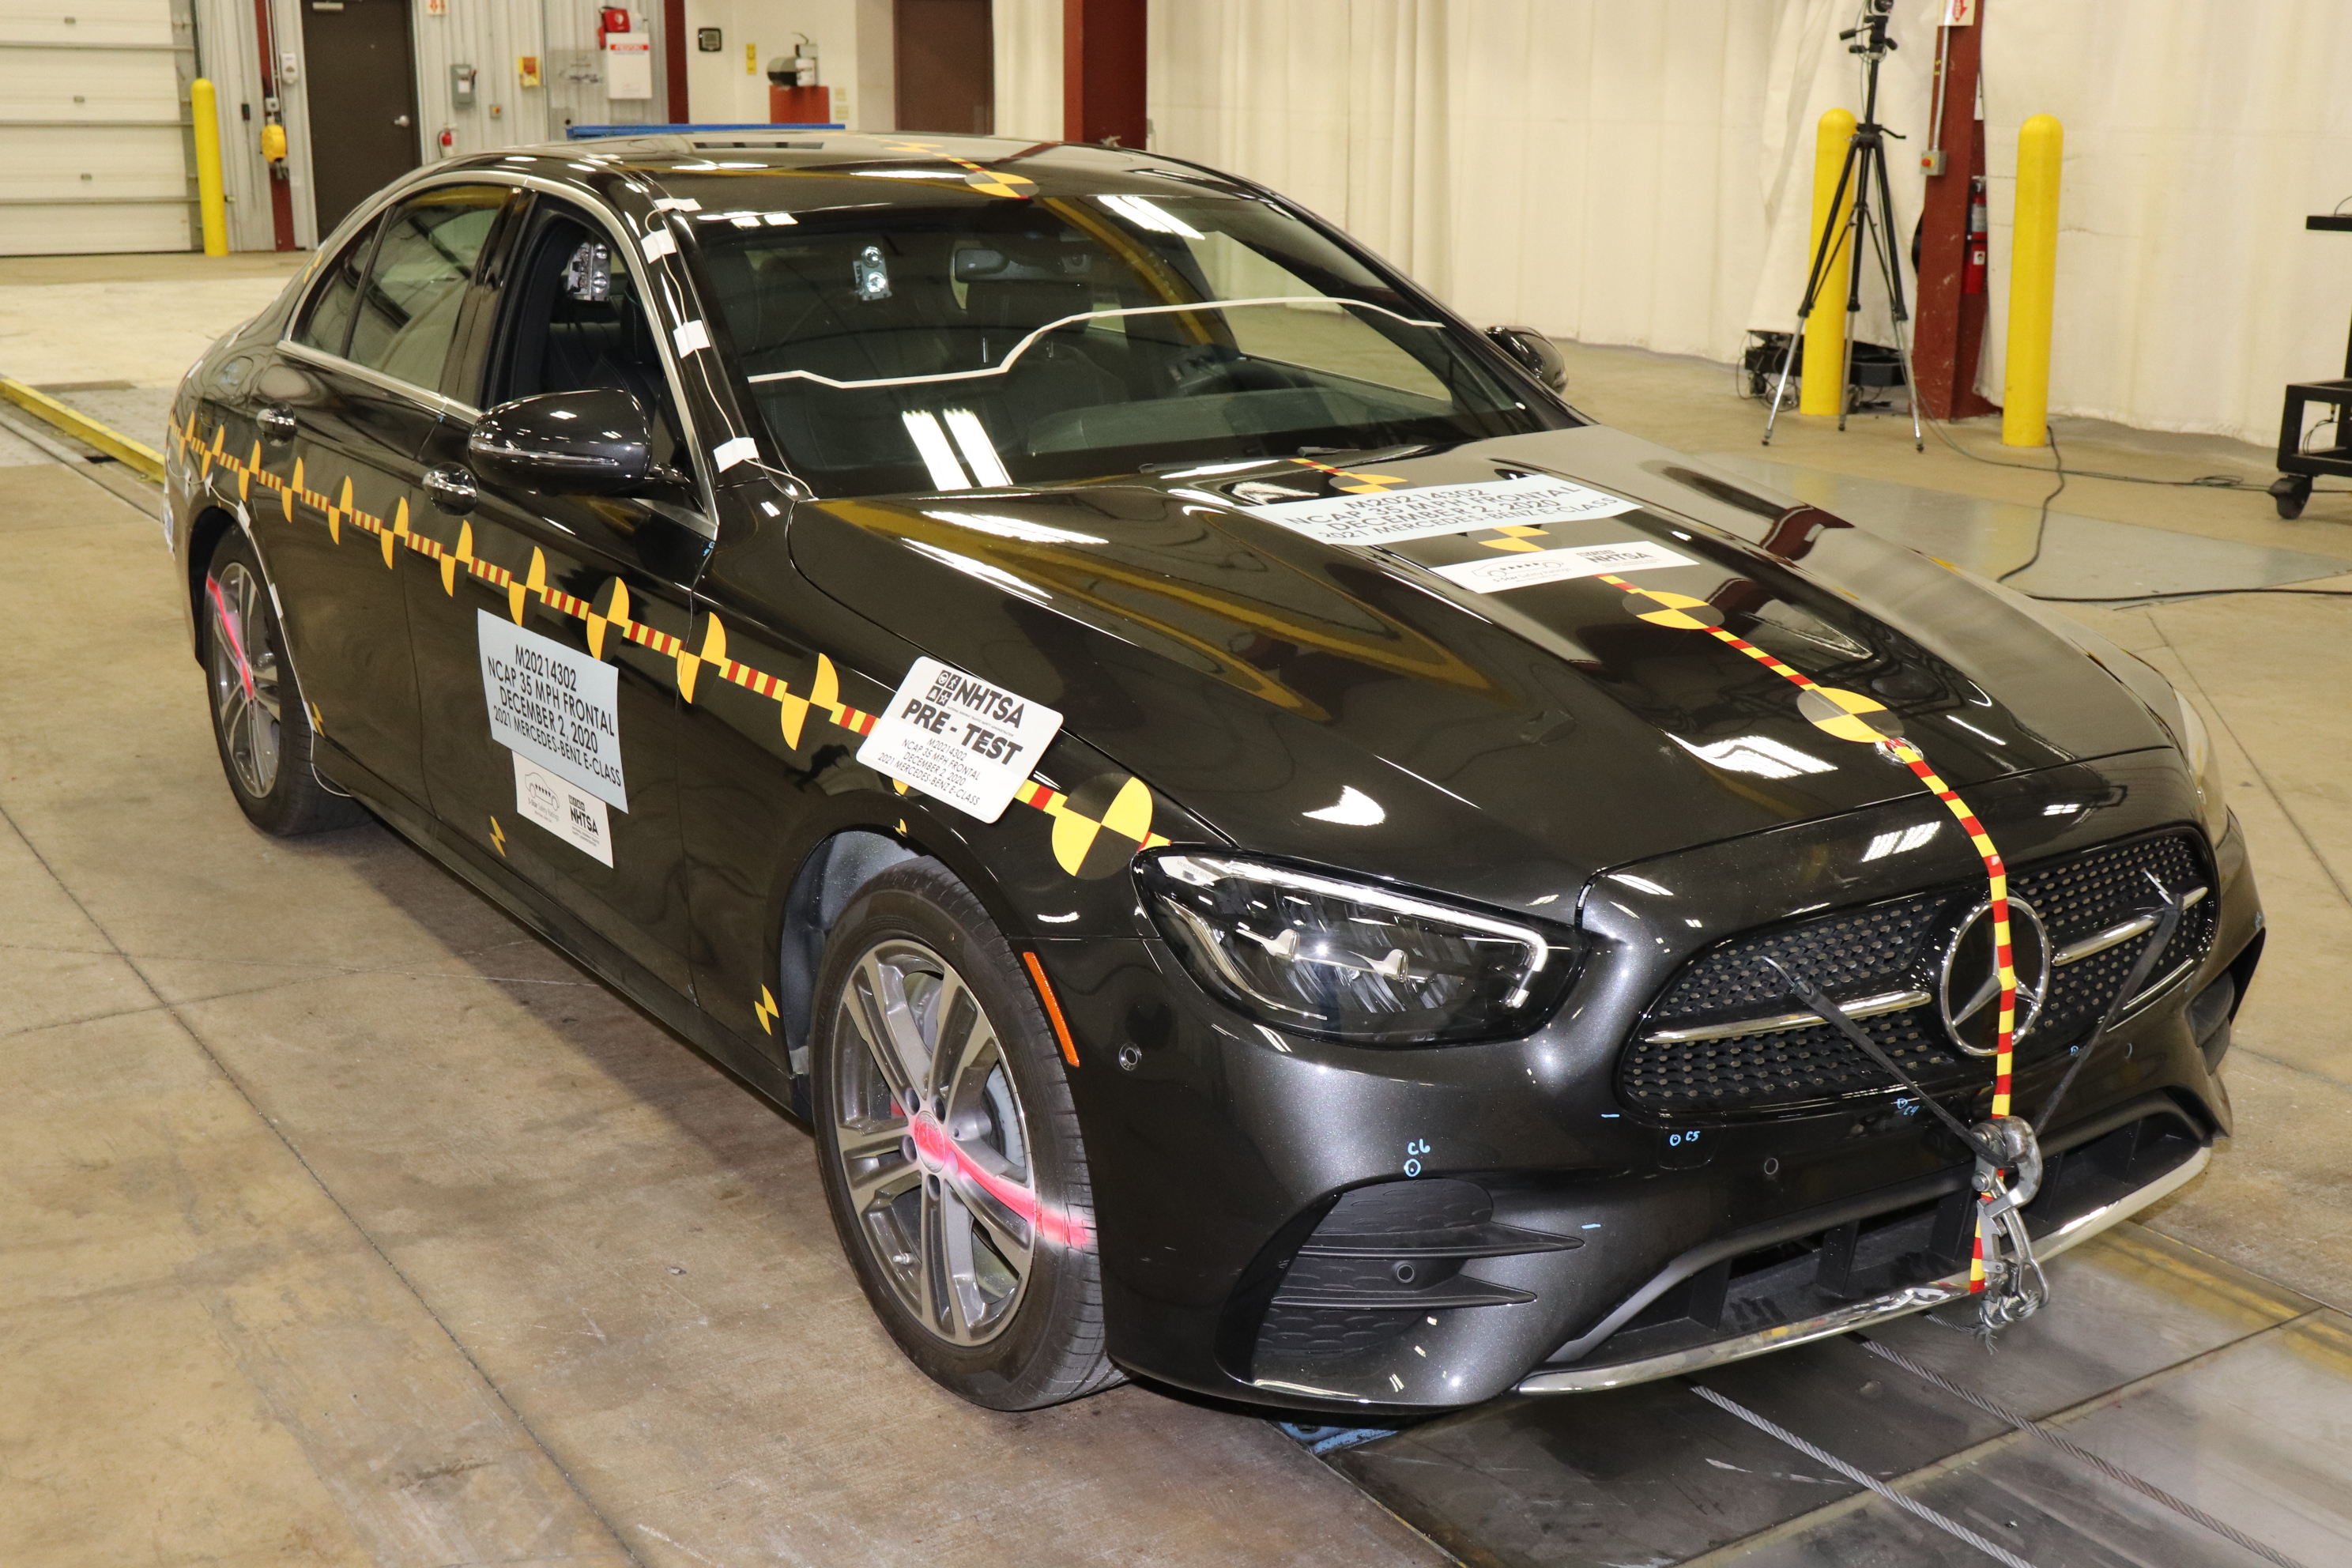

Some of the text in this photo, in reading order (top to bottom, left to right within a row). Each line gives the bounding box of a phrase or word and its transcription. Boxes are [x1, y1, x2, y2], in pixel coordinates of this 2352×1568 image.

[1285, 486, 1581, 525] NCAP 35 MPH FRONTAL
[1318, 496, 1619, 539] 2021 MERCEDES-BENZ E-CLASS
[1326, 499, 1561, 531] DECEMBER 2, 2020
[1344, 488, 1491, 510] M20214302
[1585, 552, 1655, 563] NHTSA
[515, 644, 577, 692] M20214302
[488, 655, 615, 737] NCAP 35 MPH FRONTAL
[952, 679, 1025, 729] NHTSA
[499, 685, 598, 754] DECEMBER 2, 2020
[901, 698, 952, 735] PRE
[961, 722, 1023, 765] TEST
[493, 705, 621, 787] 2021 MERCEDES-BENZ E-CLASS
[902, 739, 981, 781] NCAP 35 MPH FRONTAL
[927, 738, 967, 761] M20214302
[878, 752, 980, 805] 2021 MERCEDES-BENZ E-CLASS
[903, 752, 940, 775] DECEMBER
[947, 772, 966, 786] 2020
[569, 805, 599, 836] NHTSA
[1177, 861, 1211, 880] MERCEDES-BENZ
[1686, 1130, 1700, 1142] C5
